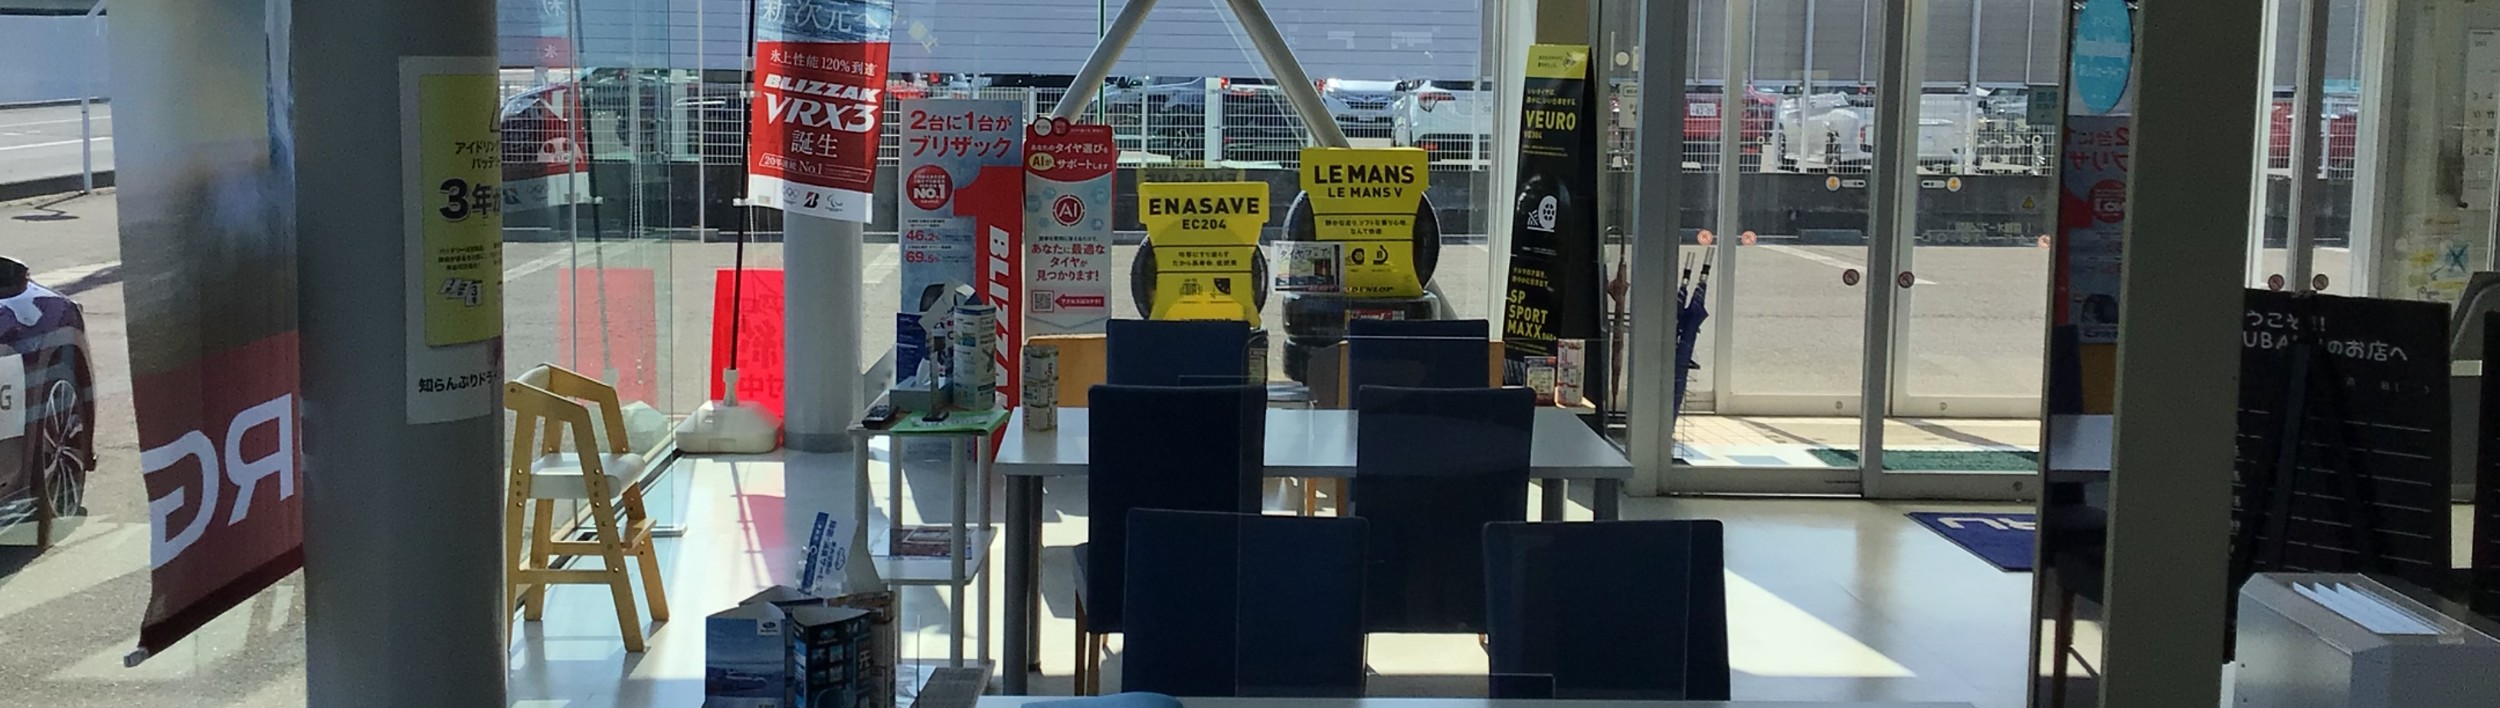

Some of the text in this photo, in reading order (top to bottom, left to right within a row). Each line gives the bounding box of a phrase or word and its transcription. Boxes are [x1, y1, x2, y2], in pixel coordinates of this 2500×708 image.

[763, 73, 882, 103] BLIZZAK
[763, 92, 879, 133] VRX3
[909, 110, 1013, 132] 2台に1台が
[1525, 109, 1576, 131] VEURO
[791, 130, 838, 158] 誕生
[909, 135, 1013, 158] ブリザック
[1314, 164, 1415, 185] LE MANS
[1328, 187, 1403, 198] LE MANS V
[1058, 202, 1078, 218] AI
[1149, 197, 1260, 216] ENASAVE
[1182, 218, 1227, 231] EC204
[1031, 243, 1105, 255] あなたに最適な
[1050, 256, 1088, 268] タイヤが
[1510, 288, 1526, 304] SP
[1508, 304, 1549, 325] SPORT
[1507, 319, 1543, 340] MAXX
